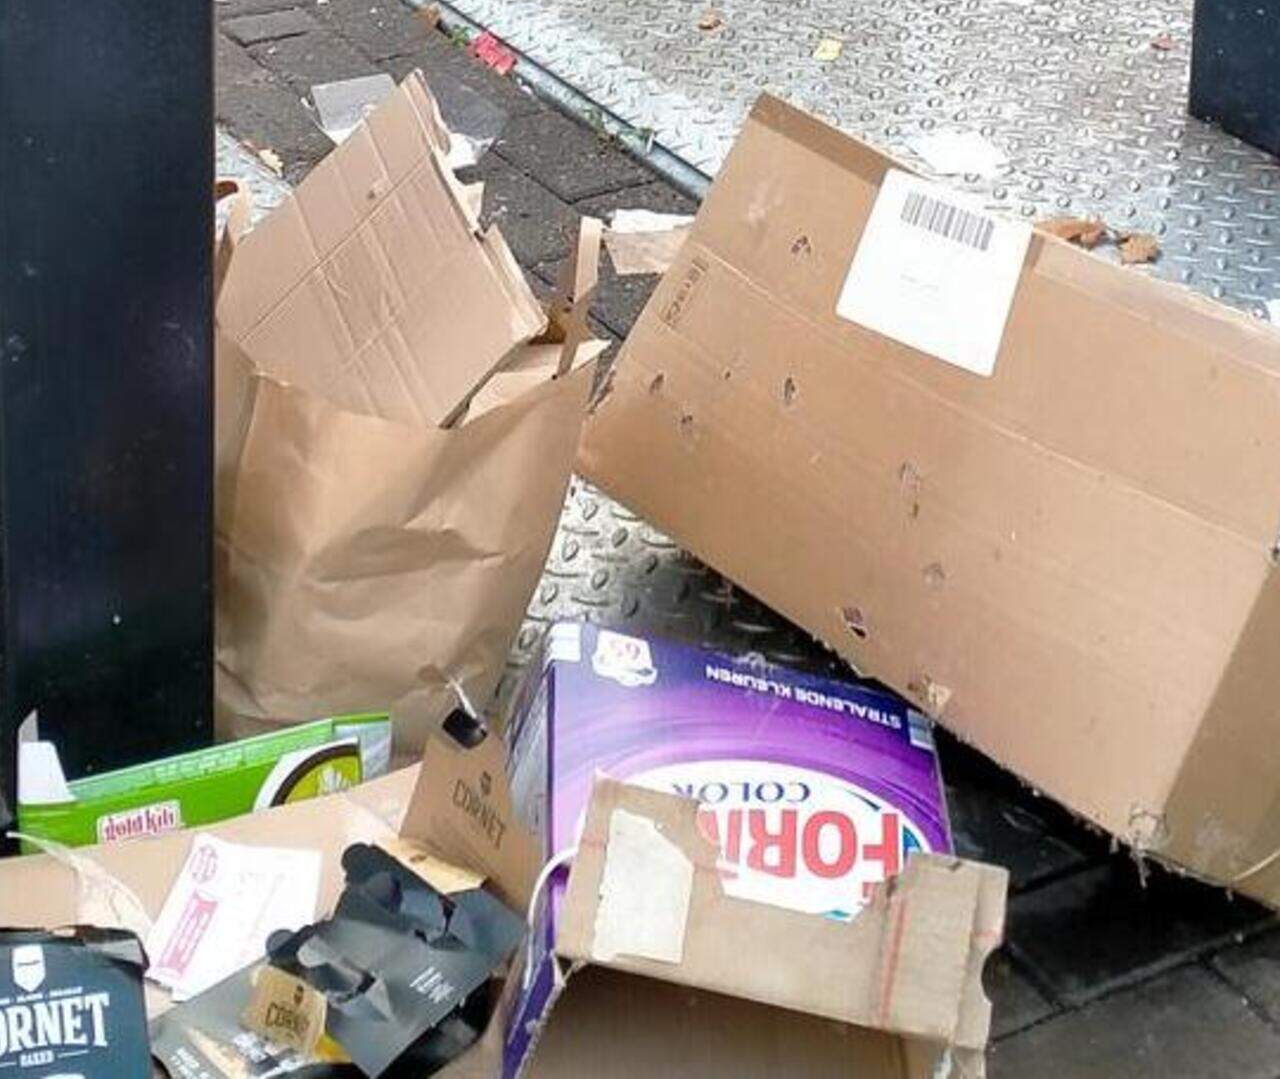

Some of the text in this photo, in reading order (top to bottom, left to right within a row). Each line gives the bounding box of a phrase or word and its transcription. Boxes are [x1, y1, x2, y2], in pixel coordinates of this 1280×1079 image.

[706, 665, 901, 729] STRALENDE KLEUREN
[452, 778, 505, 851] CORNET
